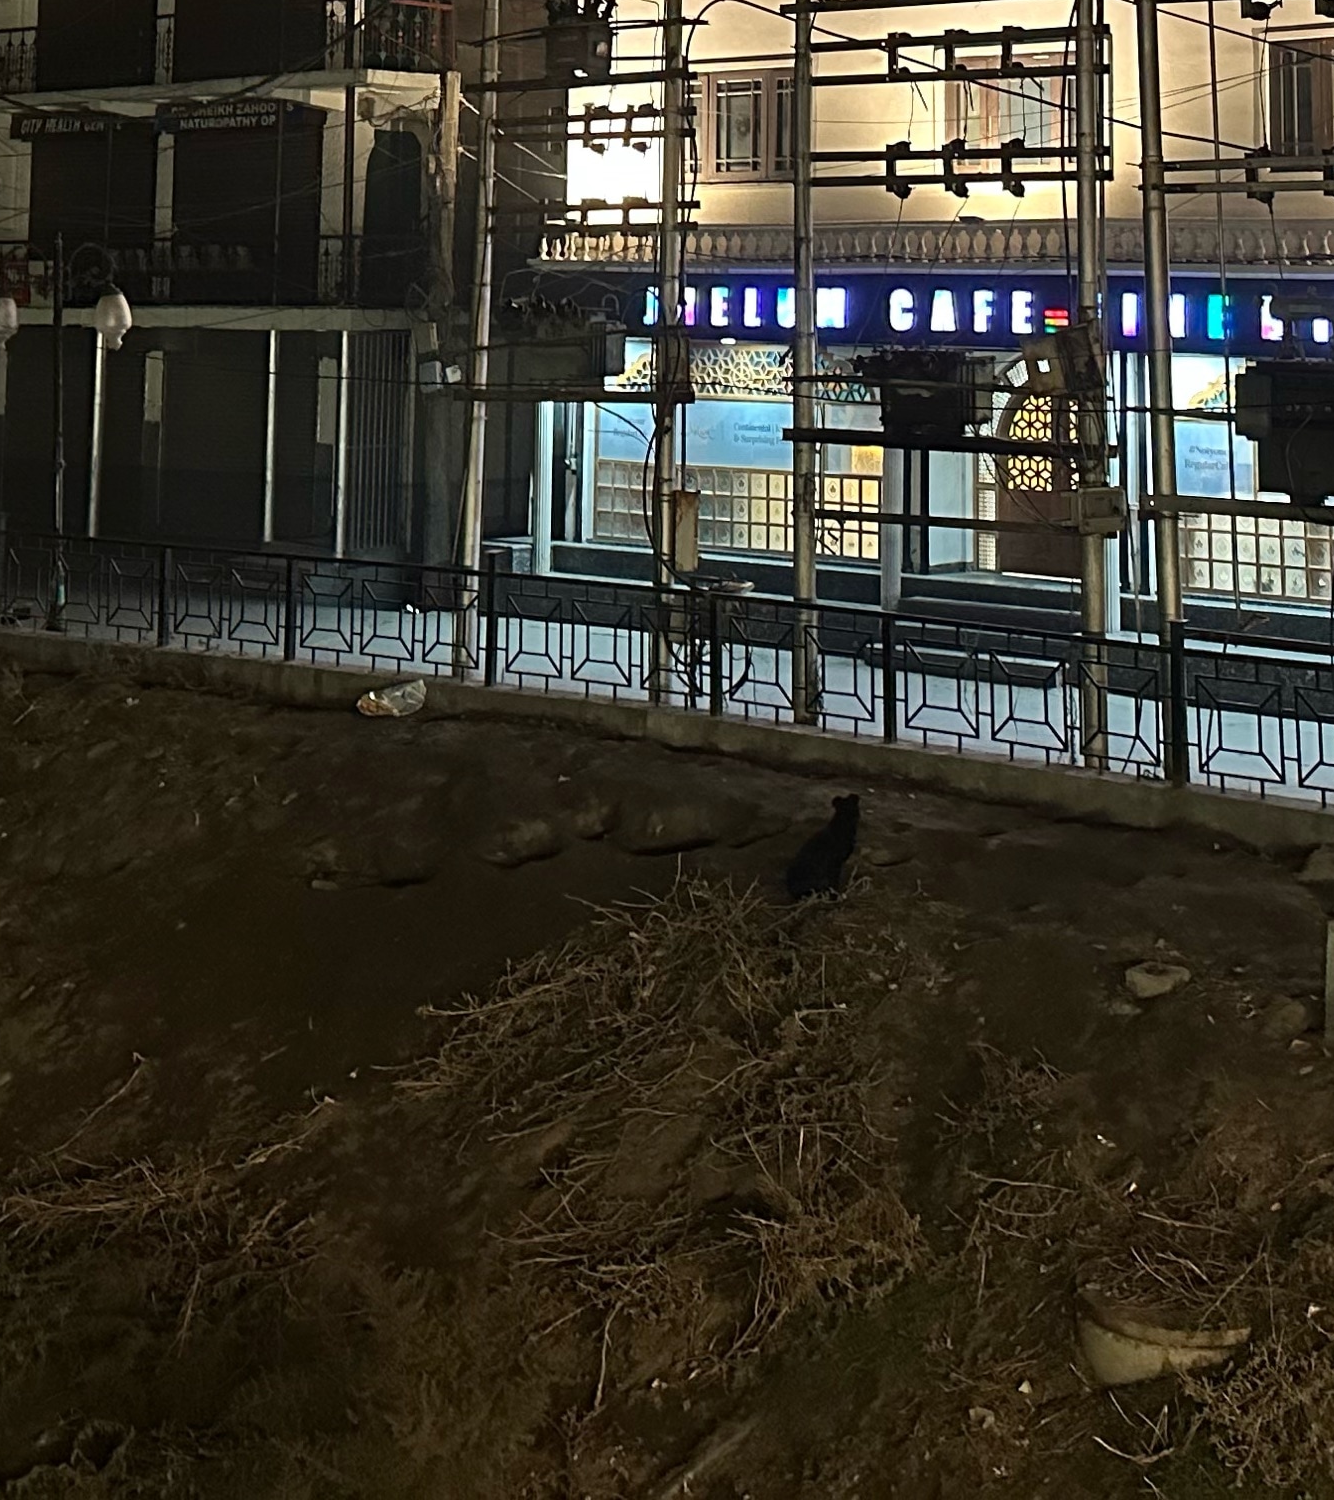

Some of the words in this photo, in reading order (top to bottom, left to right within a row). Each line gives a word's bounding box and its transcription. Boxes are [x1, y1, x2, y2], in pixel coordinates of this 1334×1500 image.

[20, 118, 43, 136] CITY
[44, 116, 81, 134] HEALTH
[888, 287, 1034, 335] CAFE
